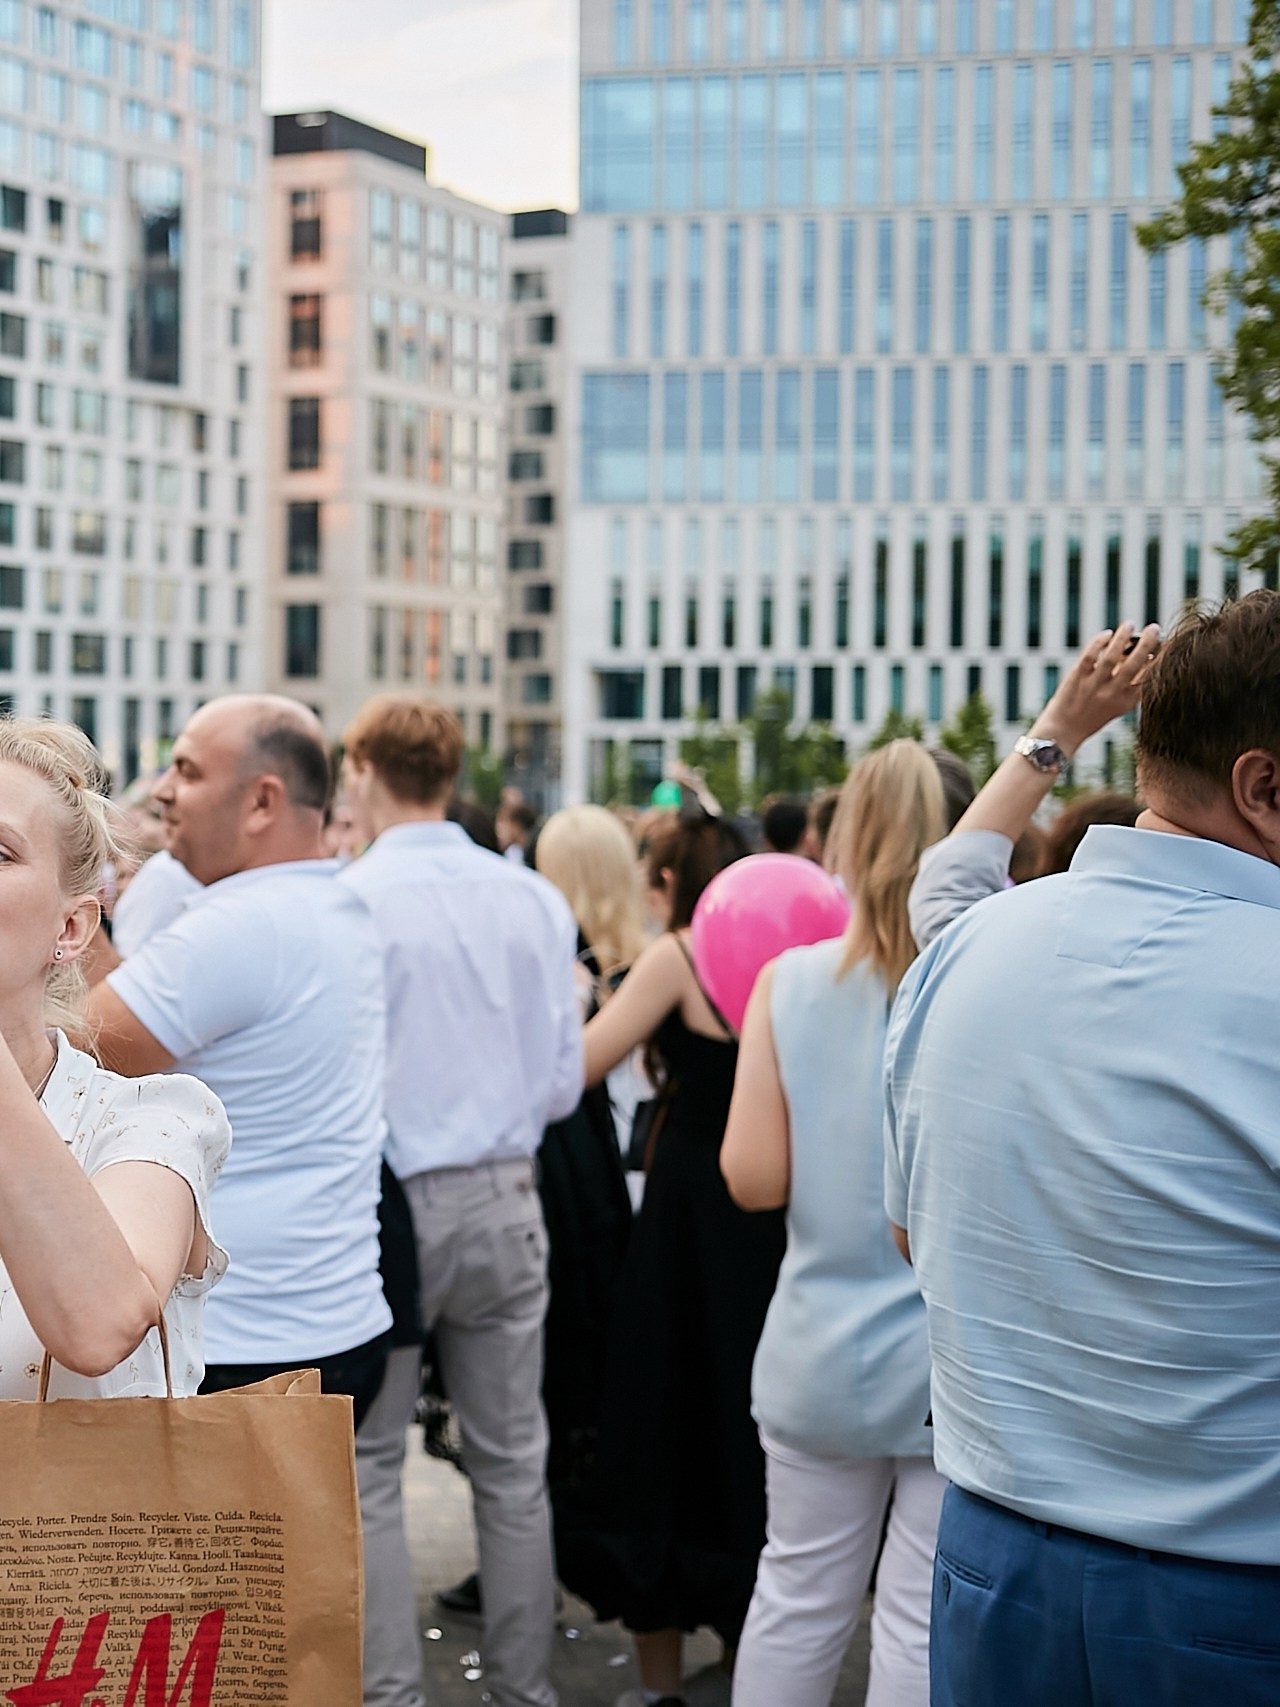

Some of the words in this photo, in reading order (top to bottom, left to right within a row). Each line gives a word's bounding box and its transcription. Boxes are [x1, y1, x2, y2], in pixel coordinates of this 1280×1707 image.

[37, 1516, 67, 1526] Porter.
[70, 1513, 107, 1524] Prendre
[111, 1512, 135, 1522] Soin.
[139, 1511, 180, 1523] Recycler.
[184, 1512, 211, 1522] Viste.
[215, 1510, 245, 1521] Cuida.
[249, 1510, 284, 1522] Recicla.
[18, 1527, 104, 1539] Wiederverwenden.
[108, 1526, 147, 1535] Носете.
[151, 1525, 192, 1536] Грижете
[22, 1542, 87, 1552] использовать
[92, 1540, 141, 1550] повторно.
[47, 1554, 76, 1564] Noste.
[78, 1552, 114, 1563] Pečujte.
[116, 1551, 167, 1562] Recyklujte.
[169, 1550, 200, 1560] Kanna.
[203, 1550, 231, 1560] Hooli.
[7, 1569, 46, 1578] Kierrätä.
[148, 1563, 180, 1573] Viseld.
[182, 1562, 227, 1573] Gondozd.
[8, 1582, 32, 1592] Ama.
[39, 1580, 73, 1591] Ricicla.
[34, 1594, 73, 1604] Носить,
[78, 1592, 114, 1603] беречь,
[119, 1592, 186, 1600] использовать
[191, 1590, 240, 1600] повторно.
[140, 1603, 184, 1614] poddawaj
[189, 1600, 250, 1612] recyklingowi.
[62, 1619, 85, 1628] uidar.
[4, 1609, 225, 1707] HM
[232, 1651, 260, 1662] Wear.
[262, 1653, 287, 1663] Care.
[216, 1664, 249, 1675] Tragen.
[251, 1665, 288, 1678] Pflegen.
